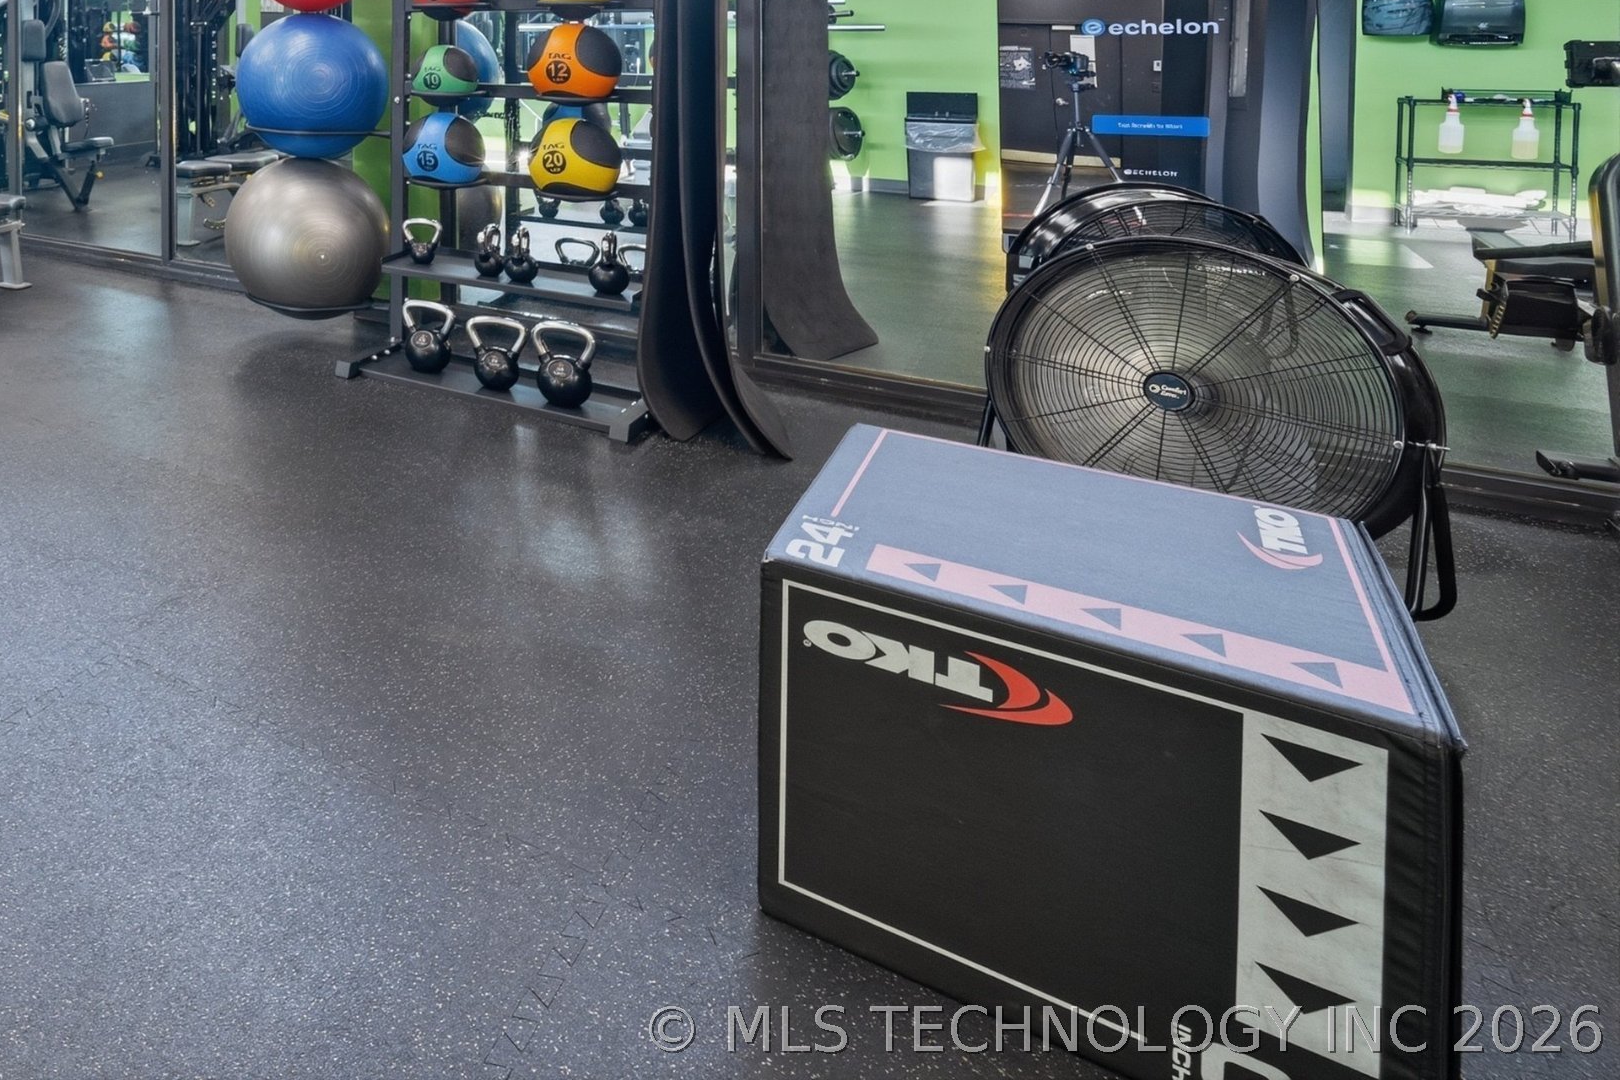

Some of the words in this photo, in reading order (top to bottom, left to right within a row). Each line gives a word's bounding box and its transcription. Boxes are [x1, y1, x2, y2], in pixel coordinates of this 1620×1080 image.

[1108, 18, 1220, 36] echelon
[548, 62, 568, 77] 12
[425, 74, 439, 86] 10
[419, 152, 435, 166] 15
[544, 152, 564, 168] 20
[1132, 169, 1179, 177] ECHELON
[1254, 507, 1309, 555] TKO
[785, 521, 854, 568] 24
[803, 620, 993, 703] TKO
